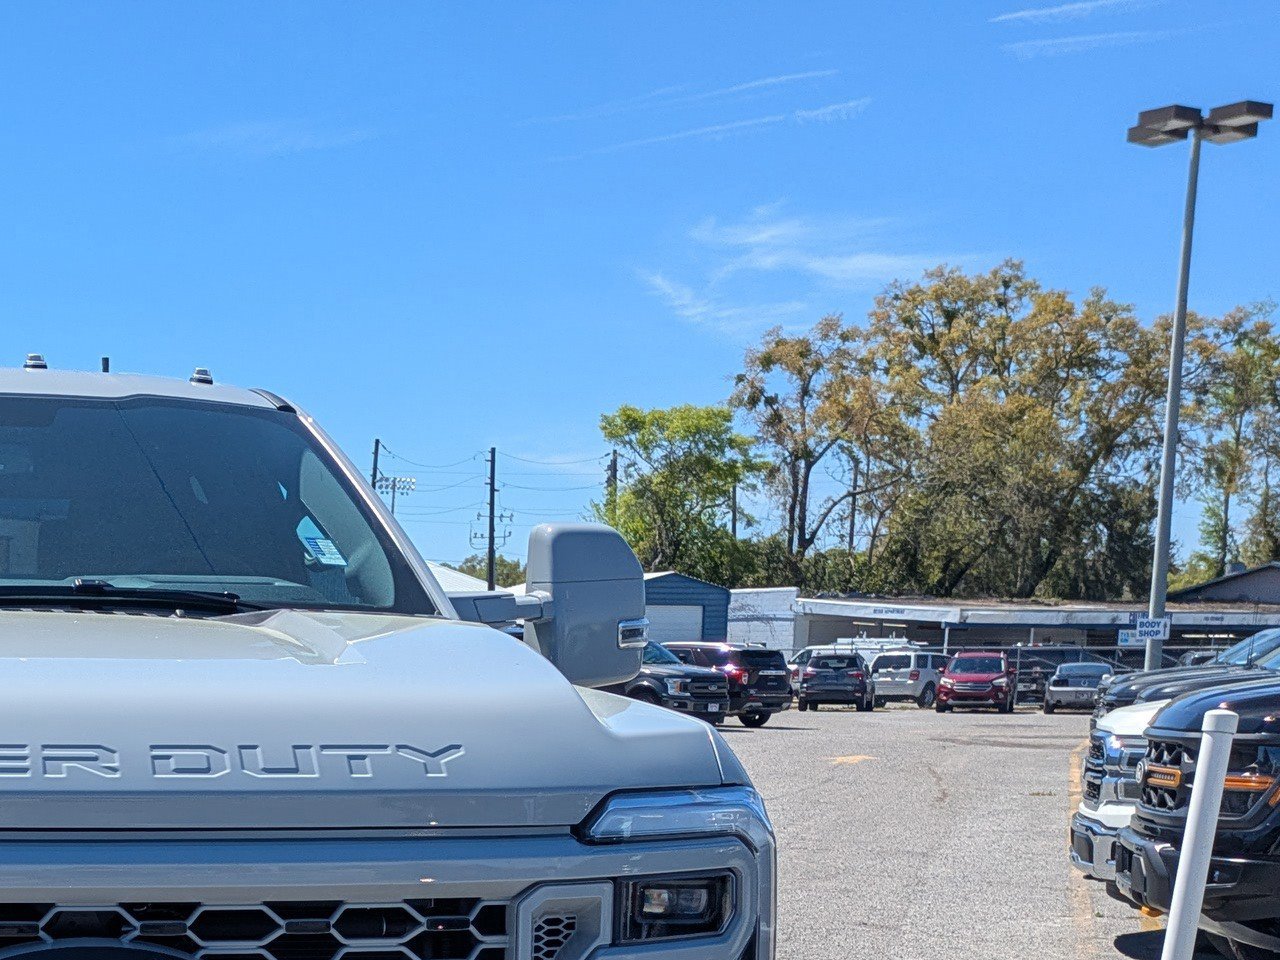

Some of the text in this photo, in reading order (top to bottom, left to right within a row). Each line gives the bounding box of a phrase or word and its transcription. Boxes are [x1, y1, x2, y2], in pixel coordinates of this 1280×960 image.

[1139, 621, 1162, 629] BODY
[1138, 629, 1161, 638] SHOP
[148, 743, 466, 778] DUTY
